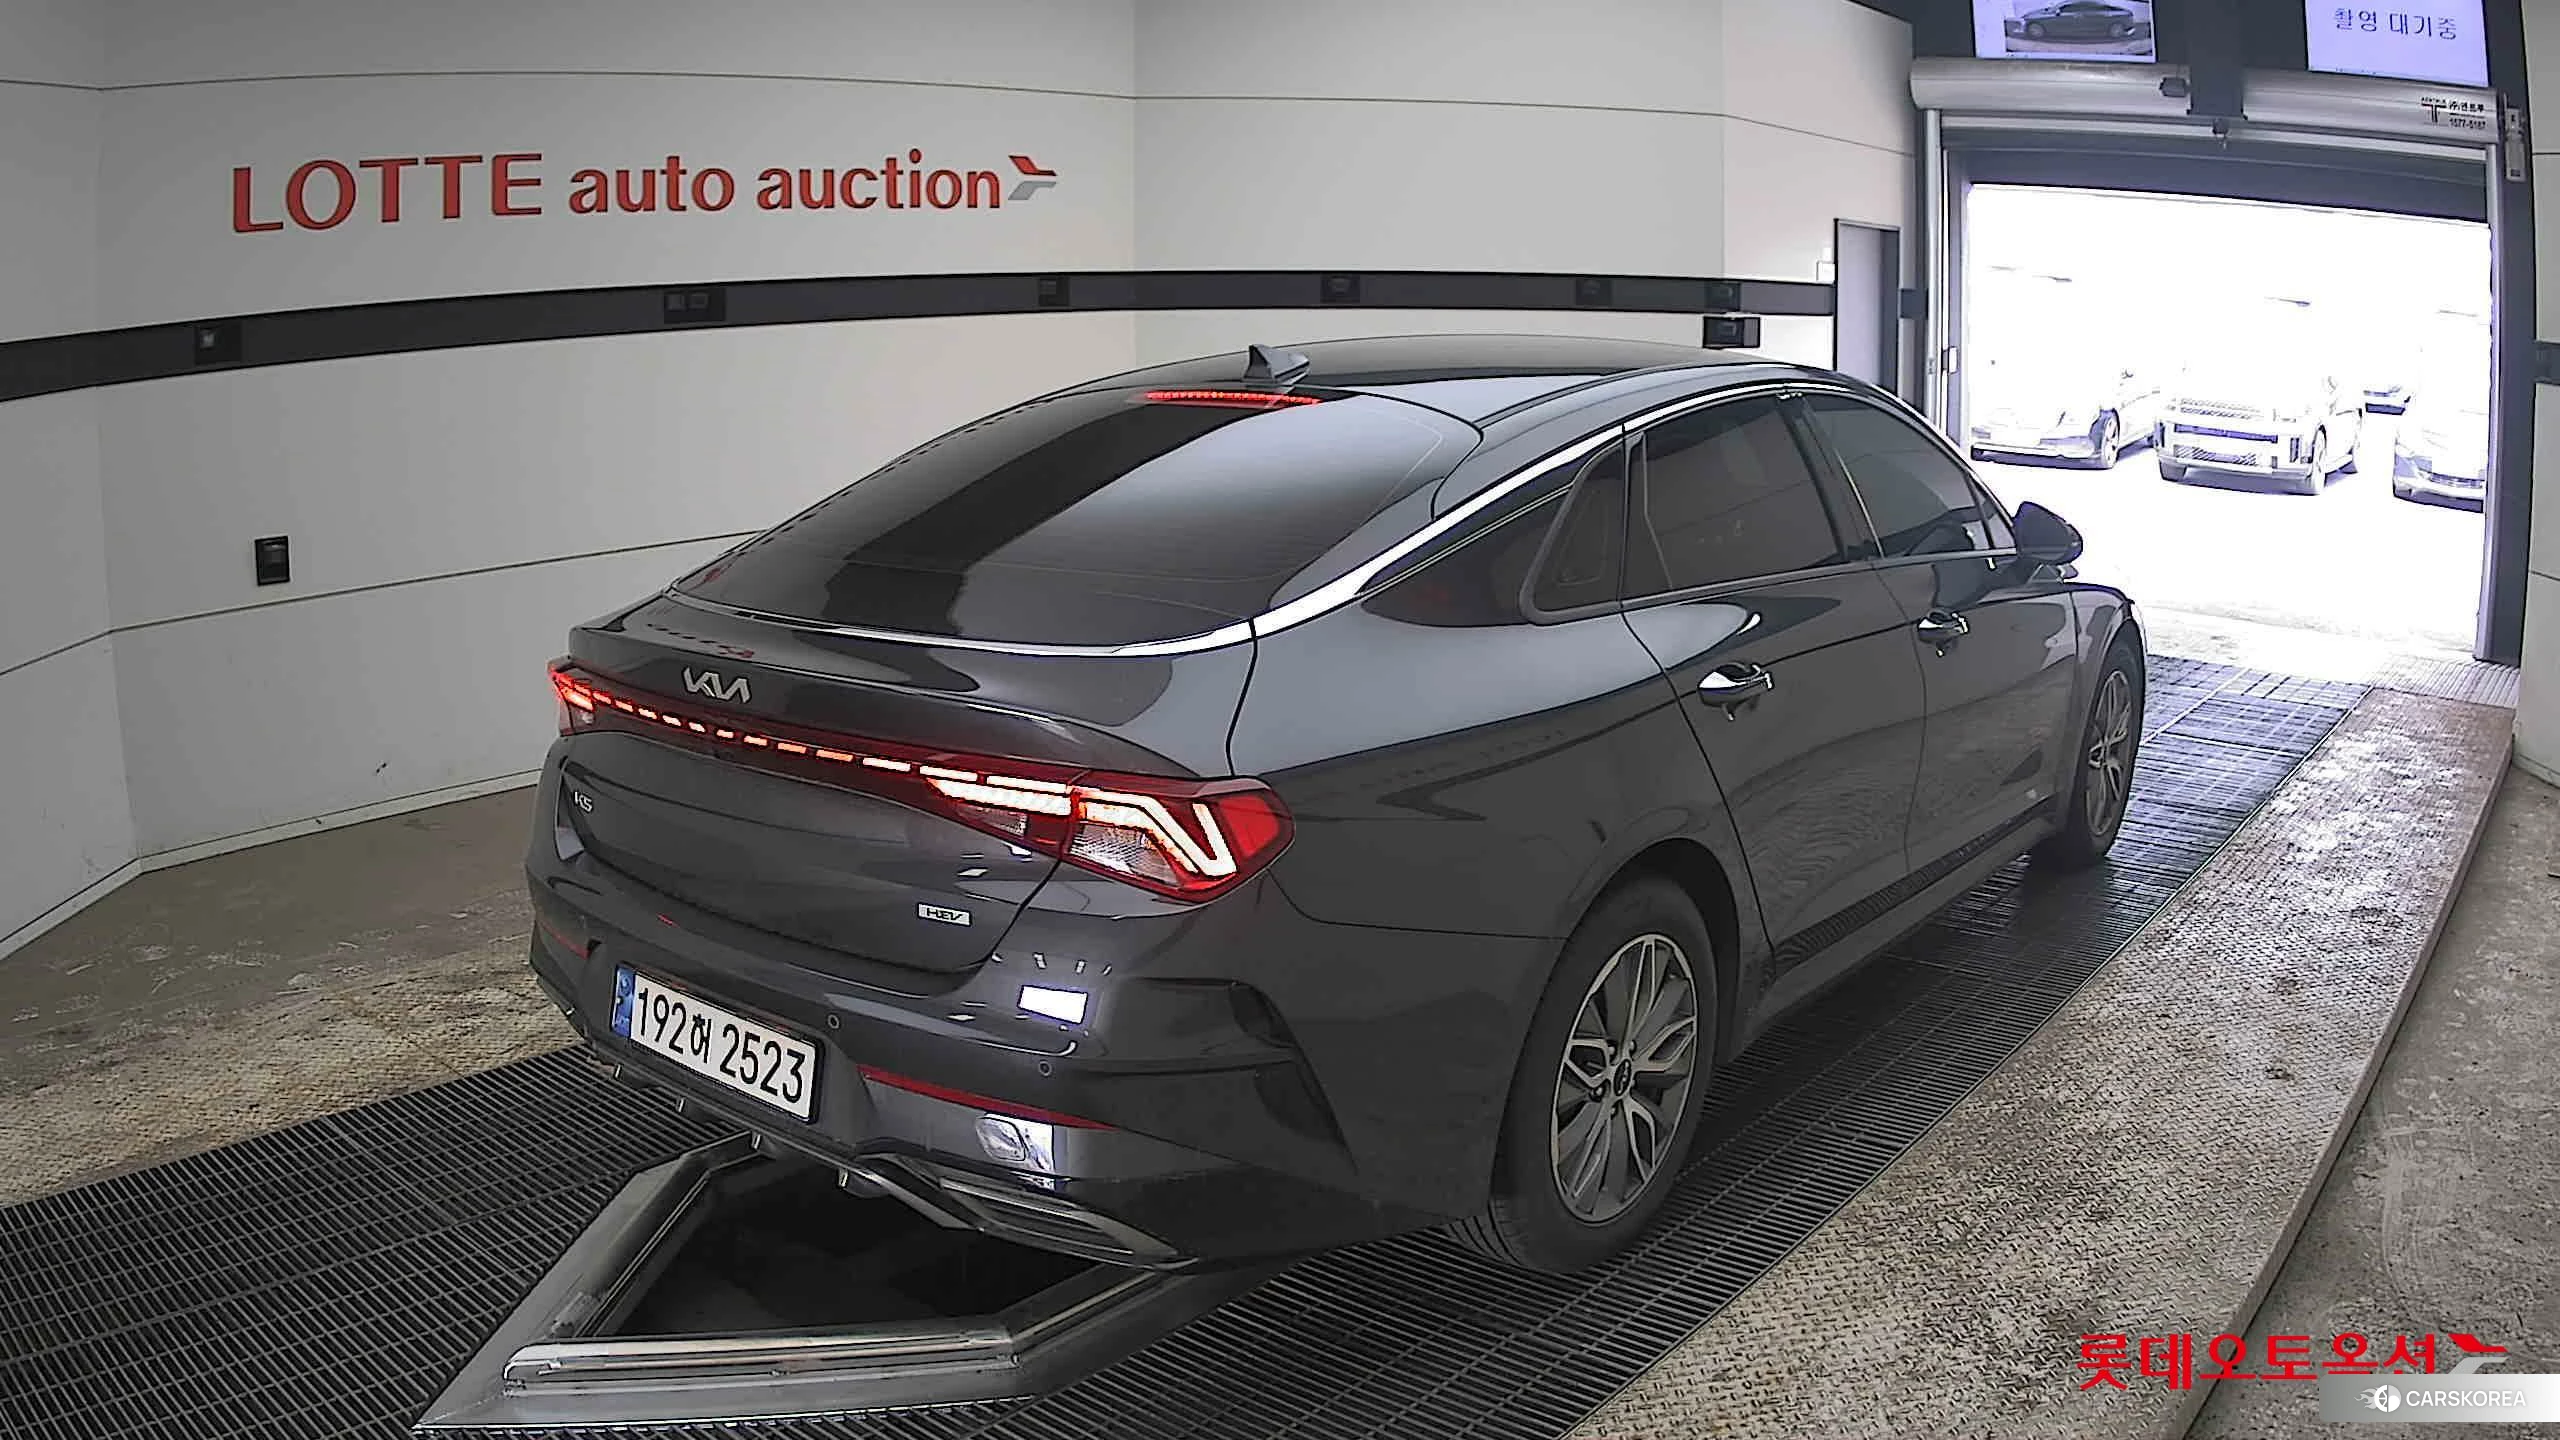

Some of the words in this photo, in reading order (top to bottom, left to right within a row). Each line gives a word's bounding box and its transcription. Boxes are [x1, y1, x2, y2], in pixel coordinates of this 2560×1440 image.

[2335, 8, 2377, 32] 촬영
[2390, 13, 2457, 40] 대기중
[233, 153, 542, 233] LOTTE
[569, 155, 735, 214] auto
[756, 148, 1000, 210] auction
[574, 791, 593, 813] K5
[926, 907, 964, 920] HEV
[638, 987, 712, 1064] 192허
[719, 1023, 806, 1104] 2523
